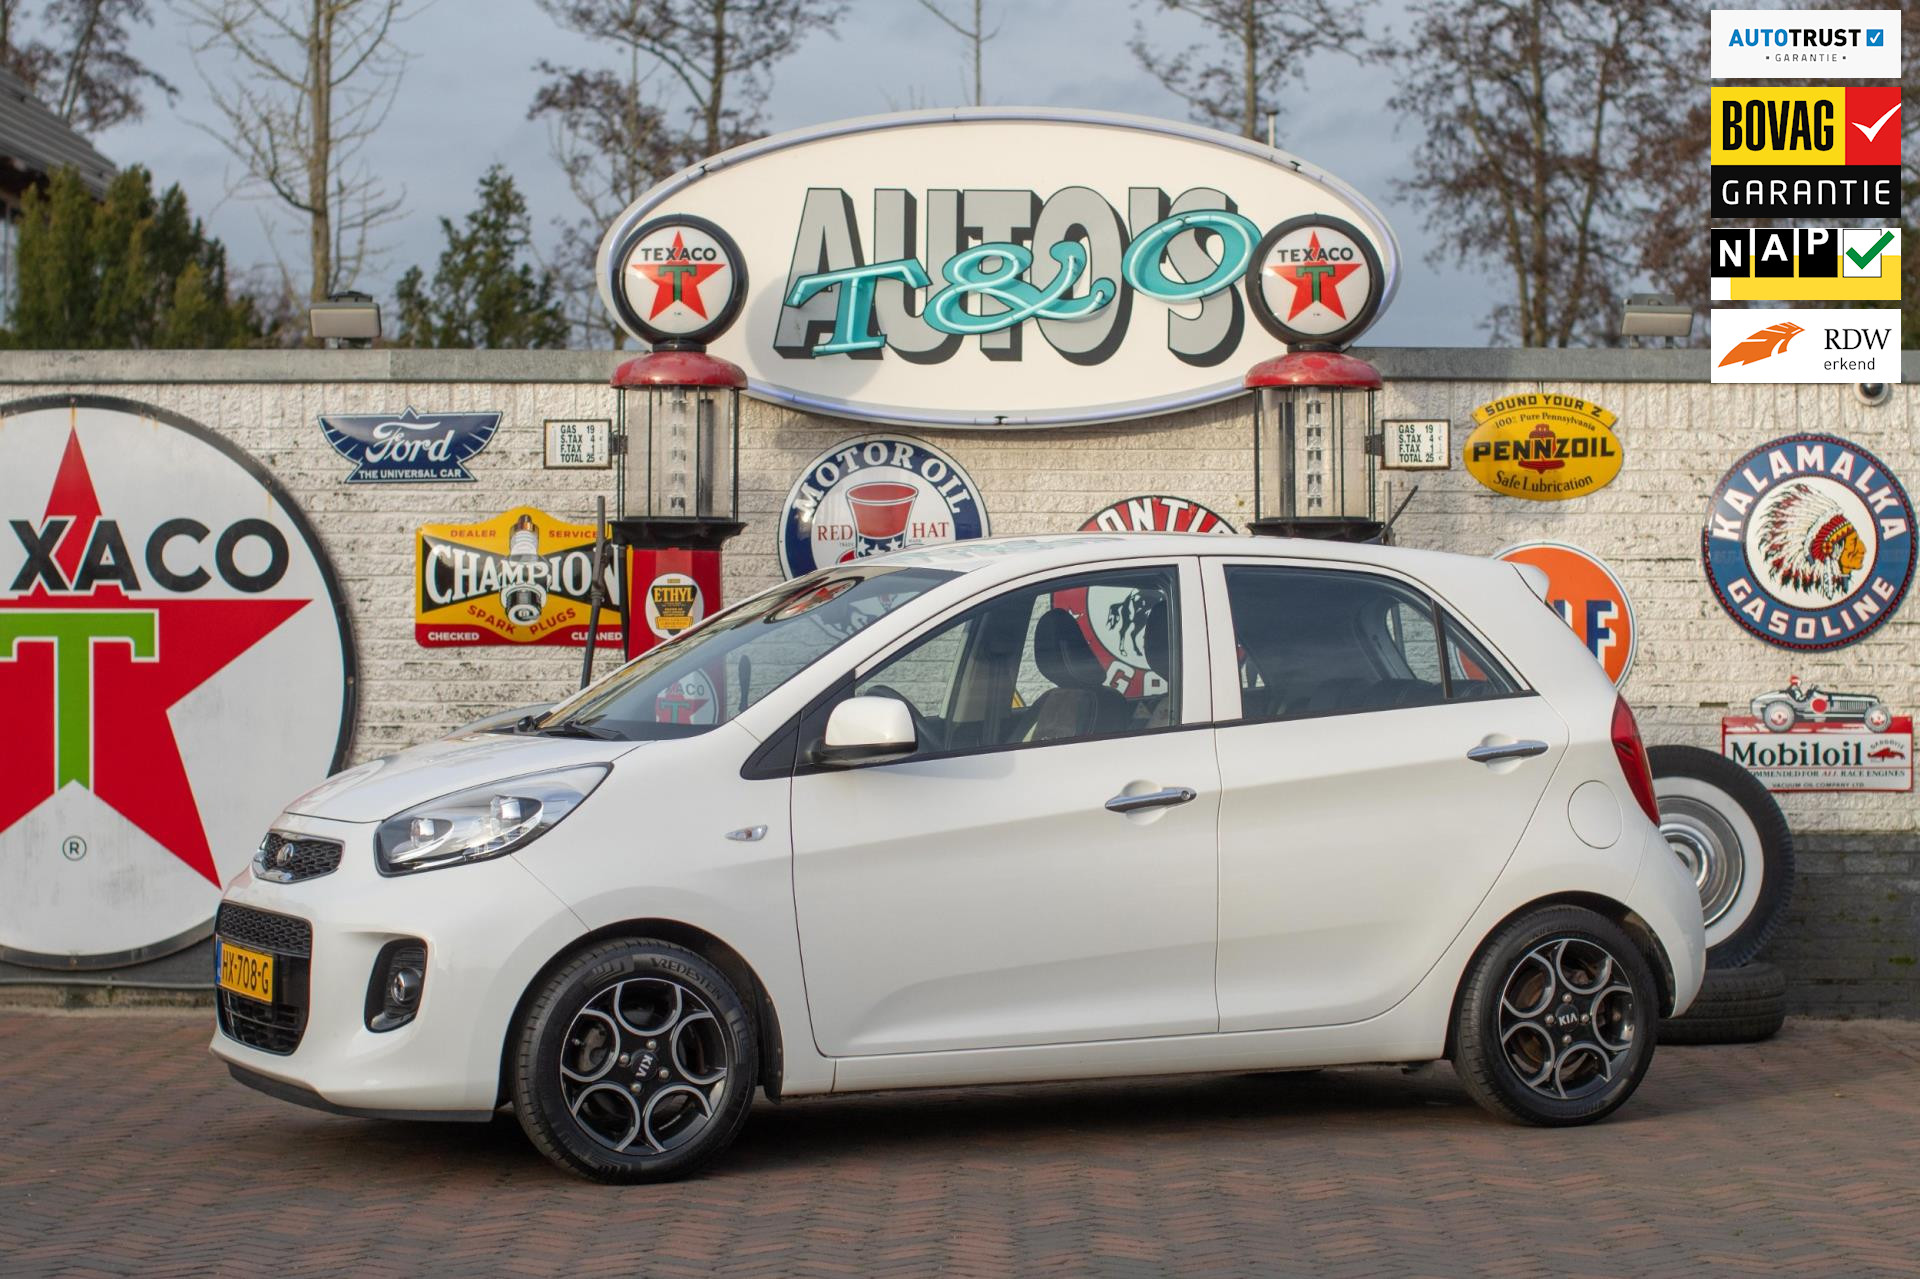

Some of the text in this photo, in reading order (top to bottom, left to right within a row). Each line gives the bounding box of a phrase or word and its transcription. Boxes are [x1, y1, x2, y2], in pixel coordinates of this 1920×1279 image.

[641, 247, 717, 261] TEXACO
[1277, 247, 1354, 262] TEXACO
[1485, 395, 1603, 418] SOUND YOUR Z
[561, 424, 577, 434] GAS
[1399, 424, 1415, 434] GAS
[1520, 413, 1540, 422] Pure
[1542, 412, 1596, 431] Pennsylvania
[365, 421, 455, 463] Ford
[561, 434, 583, 443] S.TAX
[1399, 434, 1421, 443] S.TAX
[561, 444, 581, 453] F.TAX
[1399, 444, 1420, 453] F.TAX
[1473, 437, 1616, 462] PENNZOIL
[561, 453, 583, 463] TOTAL
[1399, 453, 1423, 463] TOTAL
[359, 468, 462, 480] THE UNIVERSAL CAR
[792, 442, 971, 522] MOTOR OIL
[1493, 470, 1594, 494] Safe Lubrication
[1711, 444, 1907, 541] KALAMALKA
[450, 529, 497, 538] DEALER
[817, 522, 949, 541] RED HAT
[425, 543, 621, 607] CHAMPION
[654, 587, 694, 602] ETHYL
[1727, 576, 1895, 640] GASOLINE
[466, 604, 577, 635] SPARK PLUGS
[428, 631, 480, 641] CHECKED
[1731, 740, 1863, 767] Mobiloil
[1840, 770, 1864, 778] RACE
[1866, 770, 1905, 778] ENGINES
[221, 949, 270, 995] HX-708-G
[1558, 1012, 1578, 1026] KIA
[635, 1054, 654, 1078] KIA
